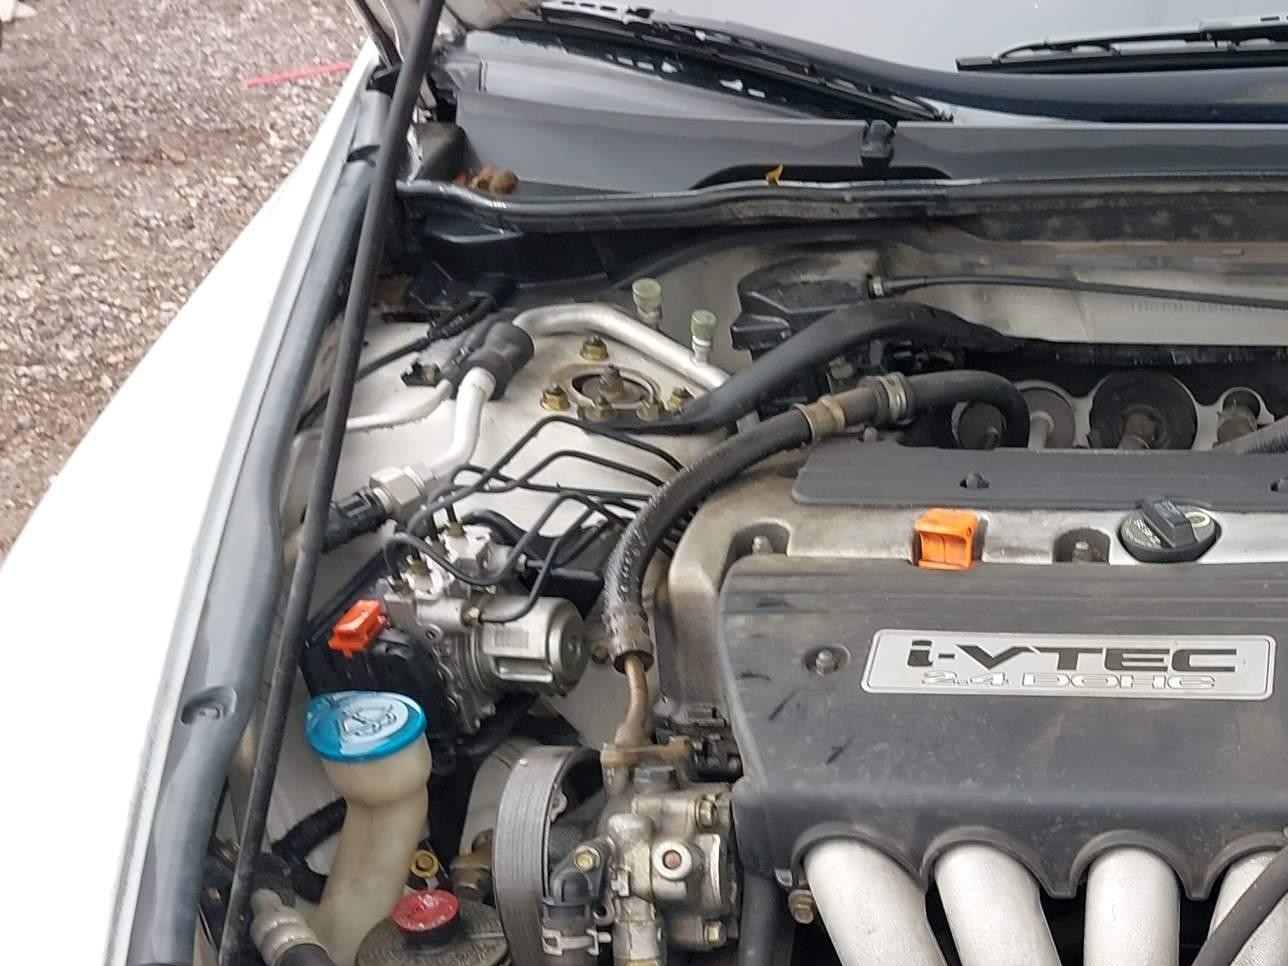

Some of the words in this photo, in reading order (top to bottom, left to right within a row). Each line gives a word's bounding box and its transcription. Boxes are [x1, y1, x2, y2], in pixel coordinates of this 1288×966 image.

[906, 639, 1238, 673] i-VTEC
[921, 670, 1009, 688] 2.4
[1022, 672, 1216, 690] DOHC
